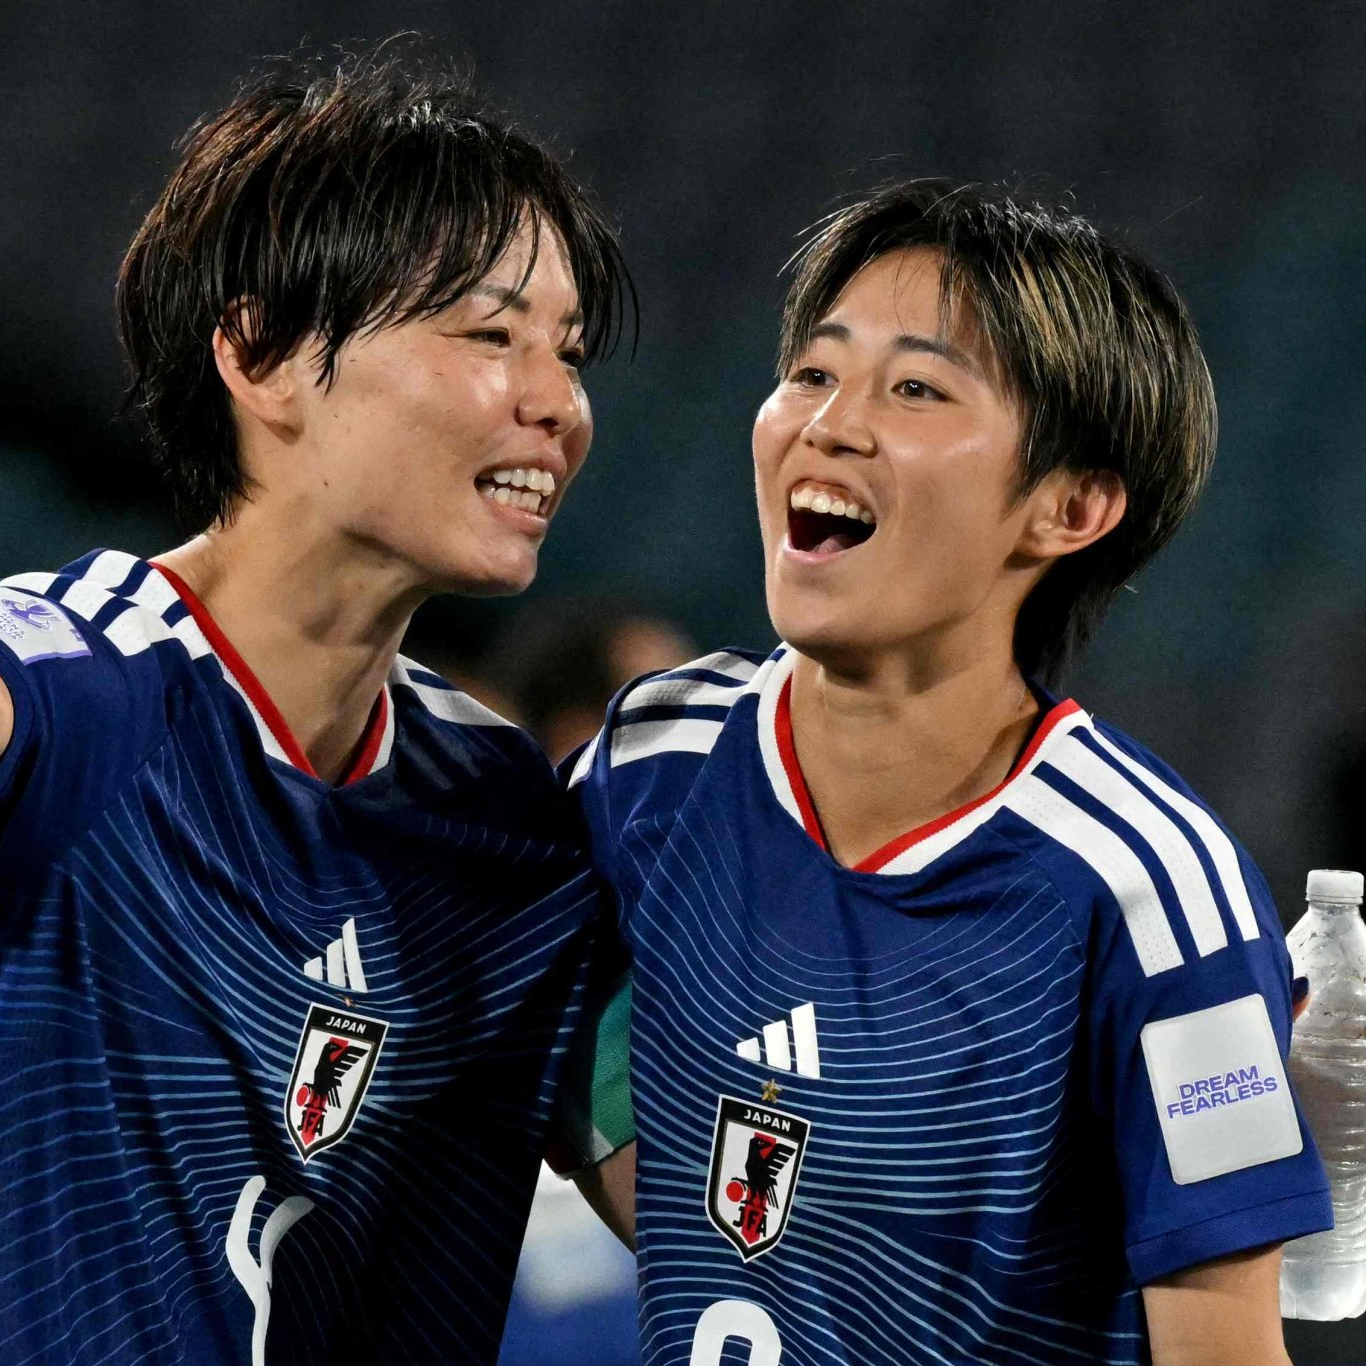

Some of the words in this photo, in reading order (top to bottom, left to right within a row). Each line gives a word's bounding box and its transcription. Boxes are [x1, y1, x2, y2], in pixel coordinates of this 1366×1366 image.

[325, 1015, 367, 1035] JAPAN
[1166, 1076, 1279, 1120] FEARLESS
[1178, 1065, 1260, 1100] DREAM
[743, 1108, 792, 1133] JAPAN
[732, 1205, 768, 1238] JFA
